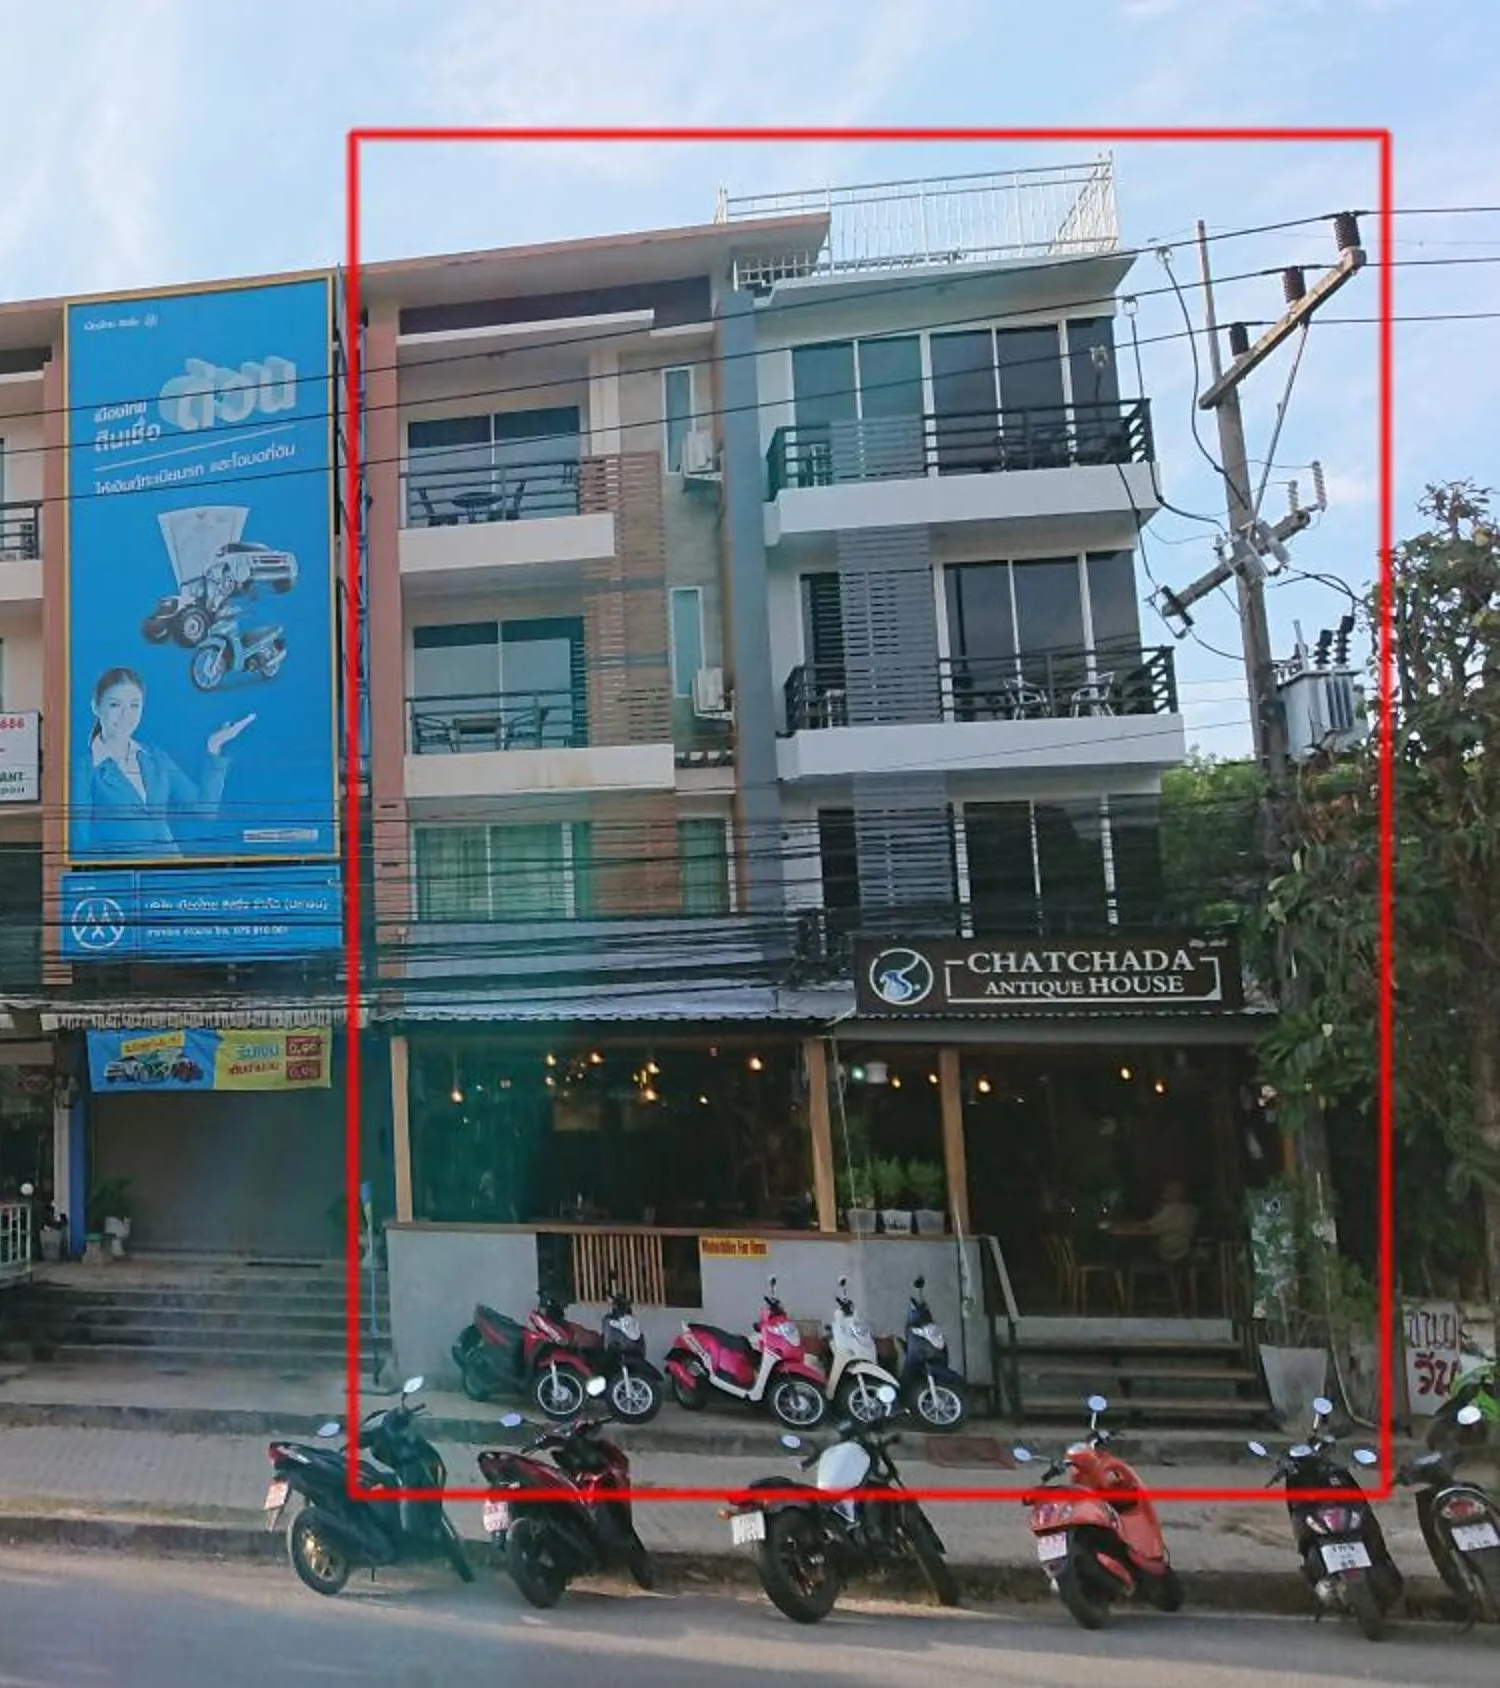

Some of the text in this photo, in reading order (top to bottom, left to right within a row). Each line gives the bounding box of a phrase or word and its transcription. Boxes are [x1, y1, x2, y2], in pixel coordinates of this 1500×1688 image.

[967, 949, 1195, 974] CHATCHADA
[985, 975, 1185, 998] ANTIQUE HOUSE
